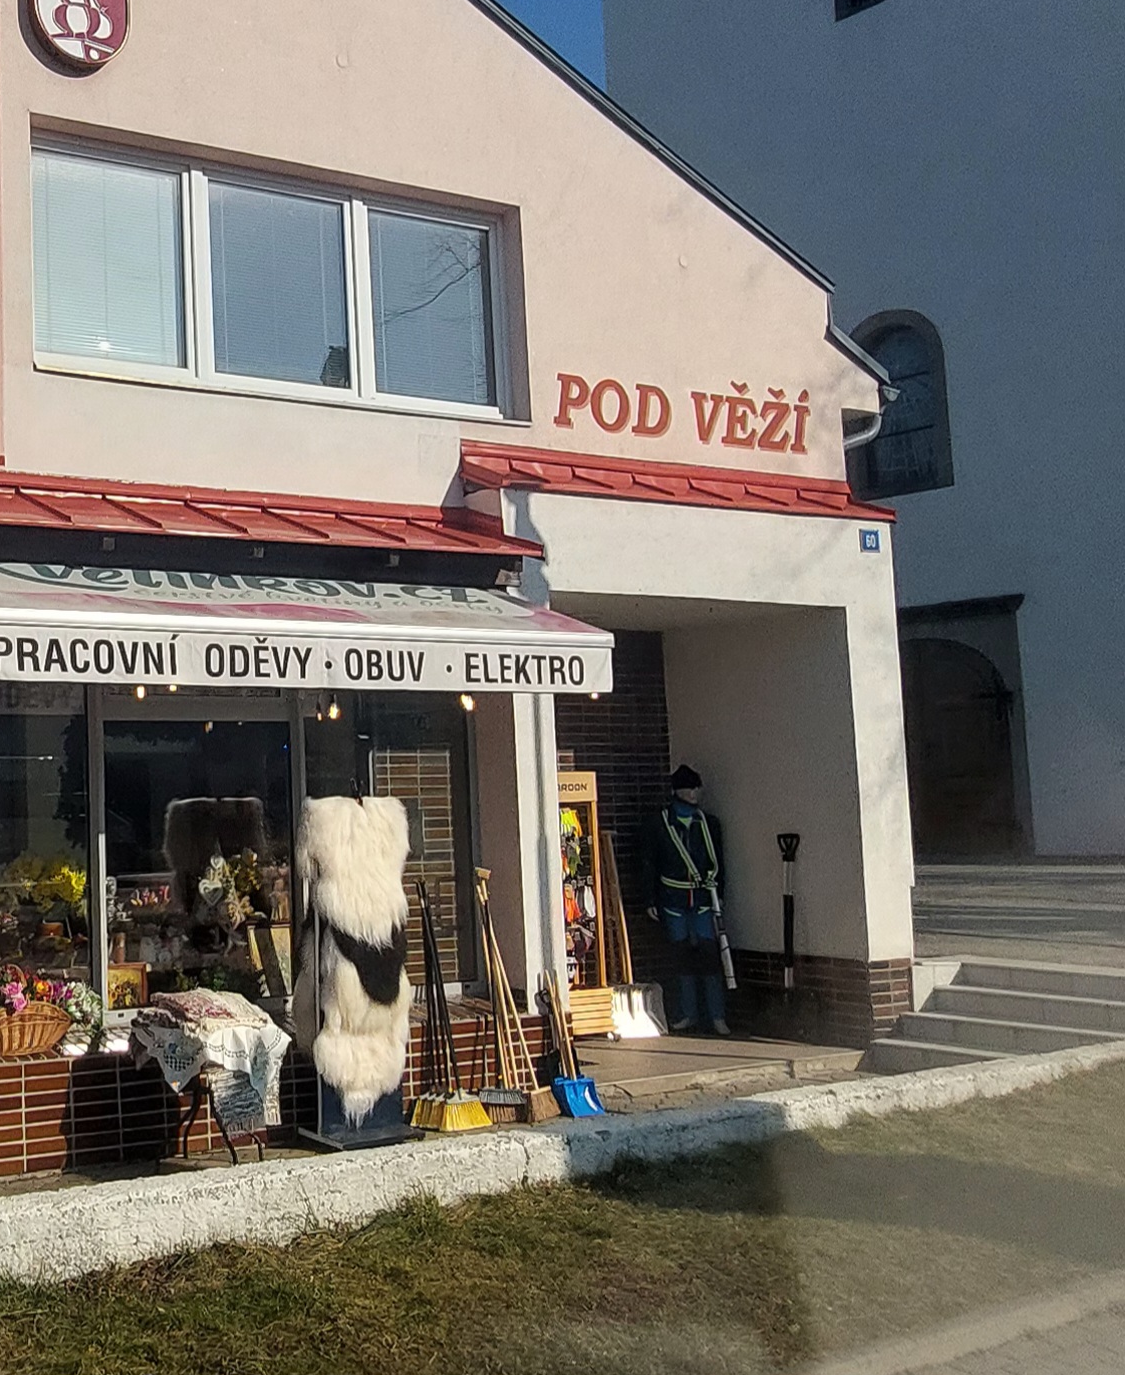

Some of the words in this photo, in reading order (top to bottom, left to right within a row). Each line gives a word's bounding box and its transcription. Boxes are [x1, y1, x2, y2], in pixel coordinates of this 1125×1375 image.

[553, 372, 672, 437] POD
[691, 380, 811, 455] VĚŽÍ
[205, 636, 313, 679] ODĚVY
[345, 648, 425, 682] OBUV
[464, 652, 585, 686] ELEKTRO
